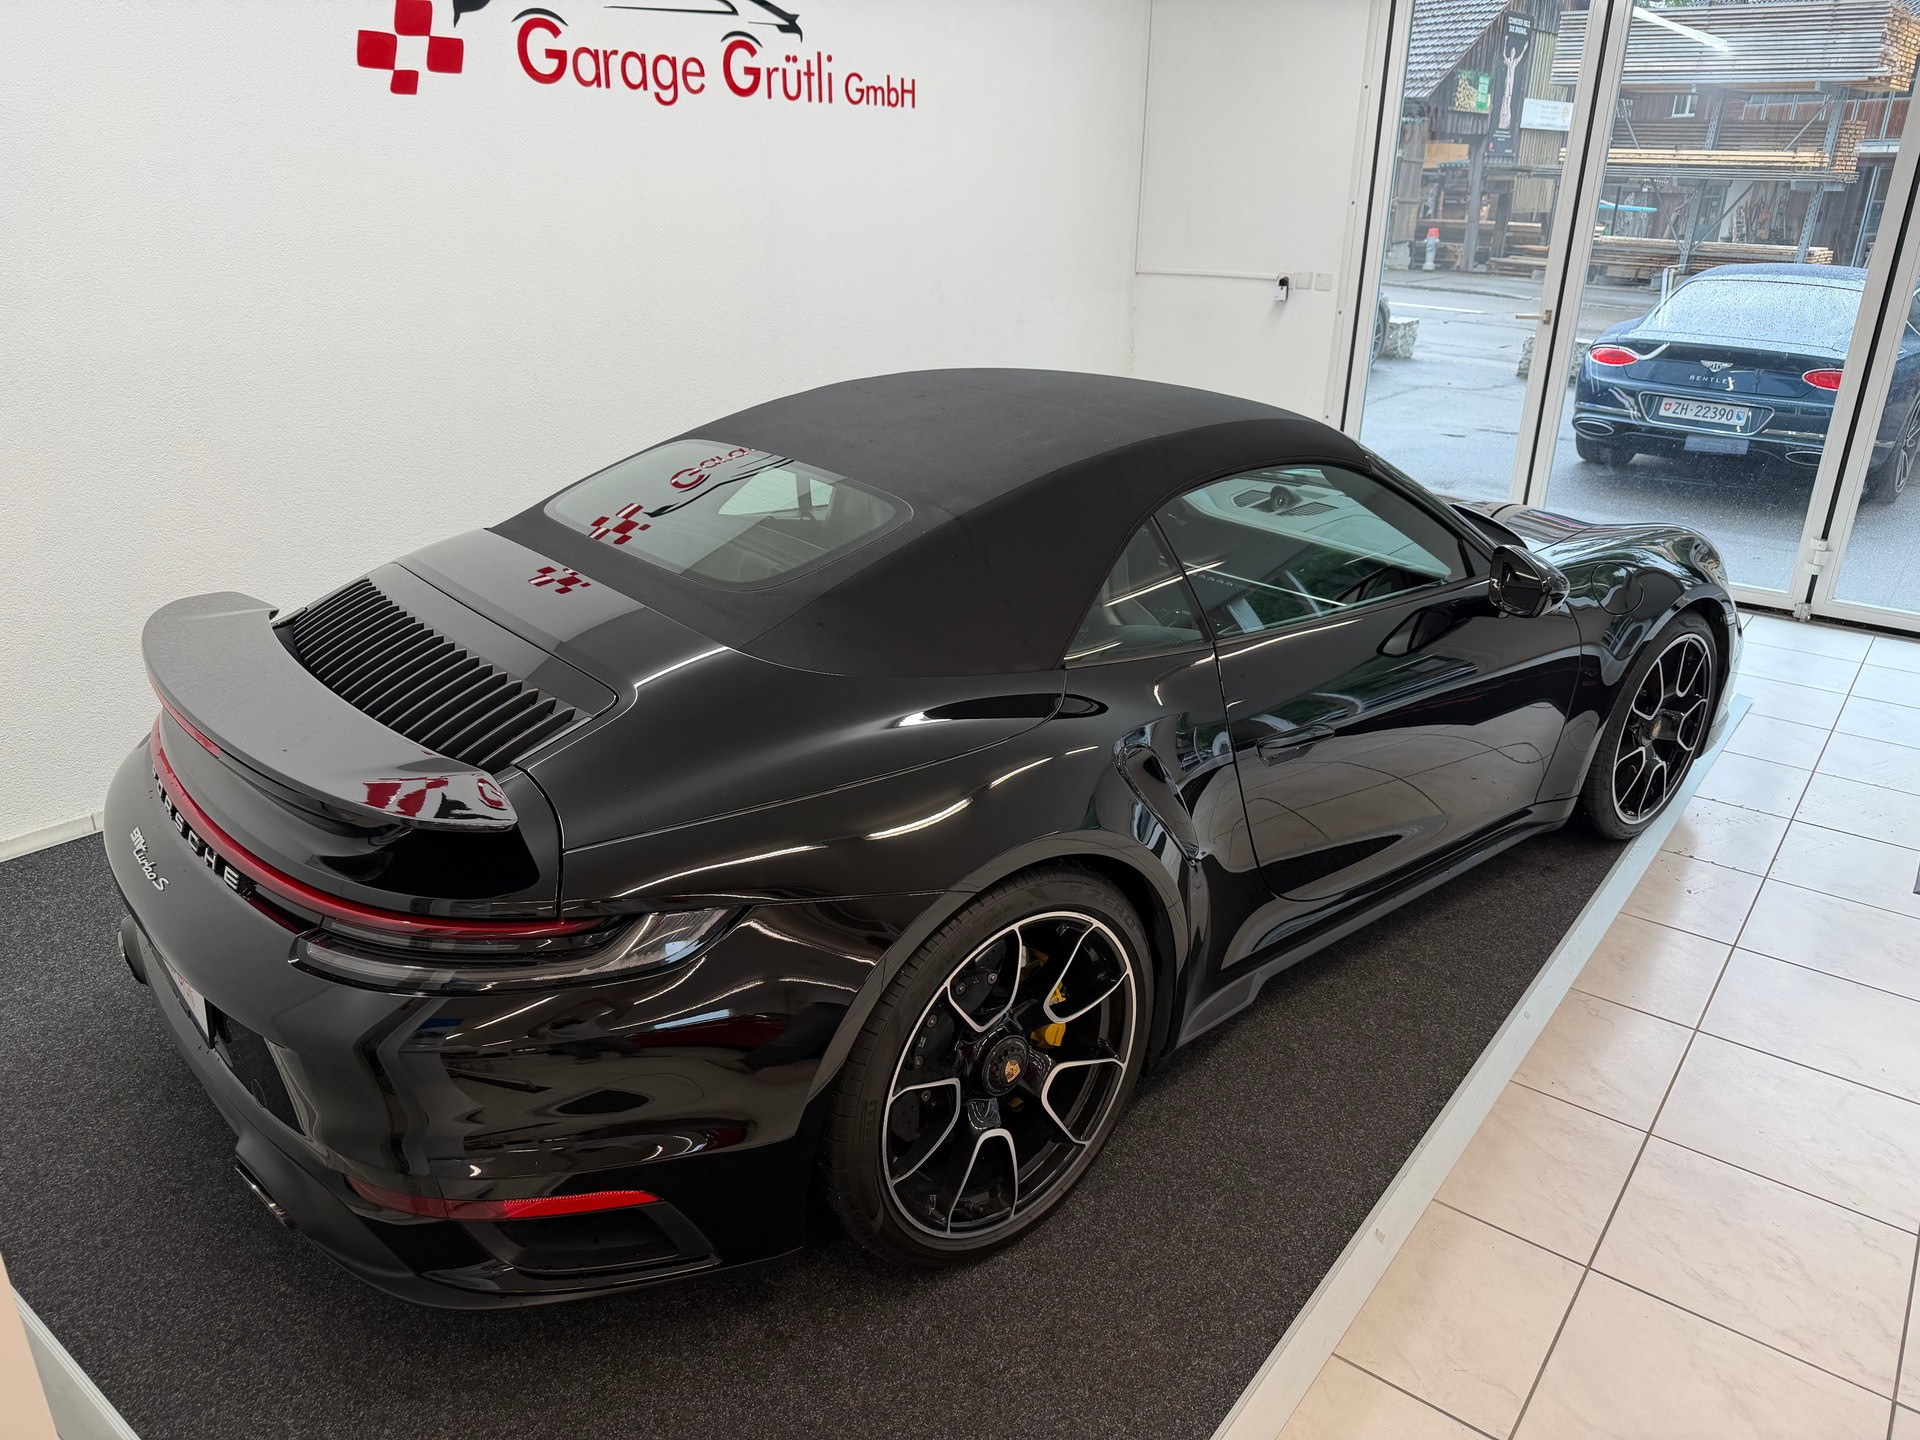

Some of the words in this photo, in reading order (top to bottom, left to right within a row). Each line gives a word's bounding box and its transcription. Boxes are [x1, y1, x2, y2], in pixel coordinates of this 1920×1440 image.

[516, 17, 706, 106] Garage
[722, 39, 833, 104] Grütli
[844, 72, 916, 109] GmbH
